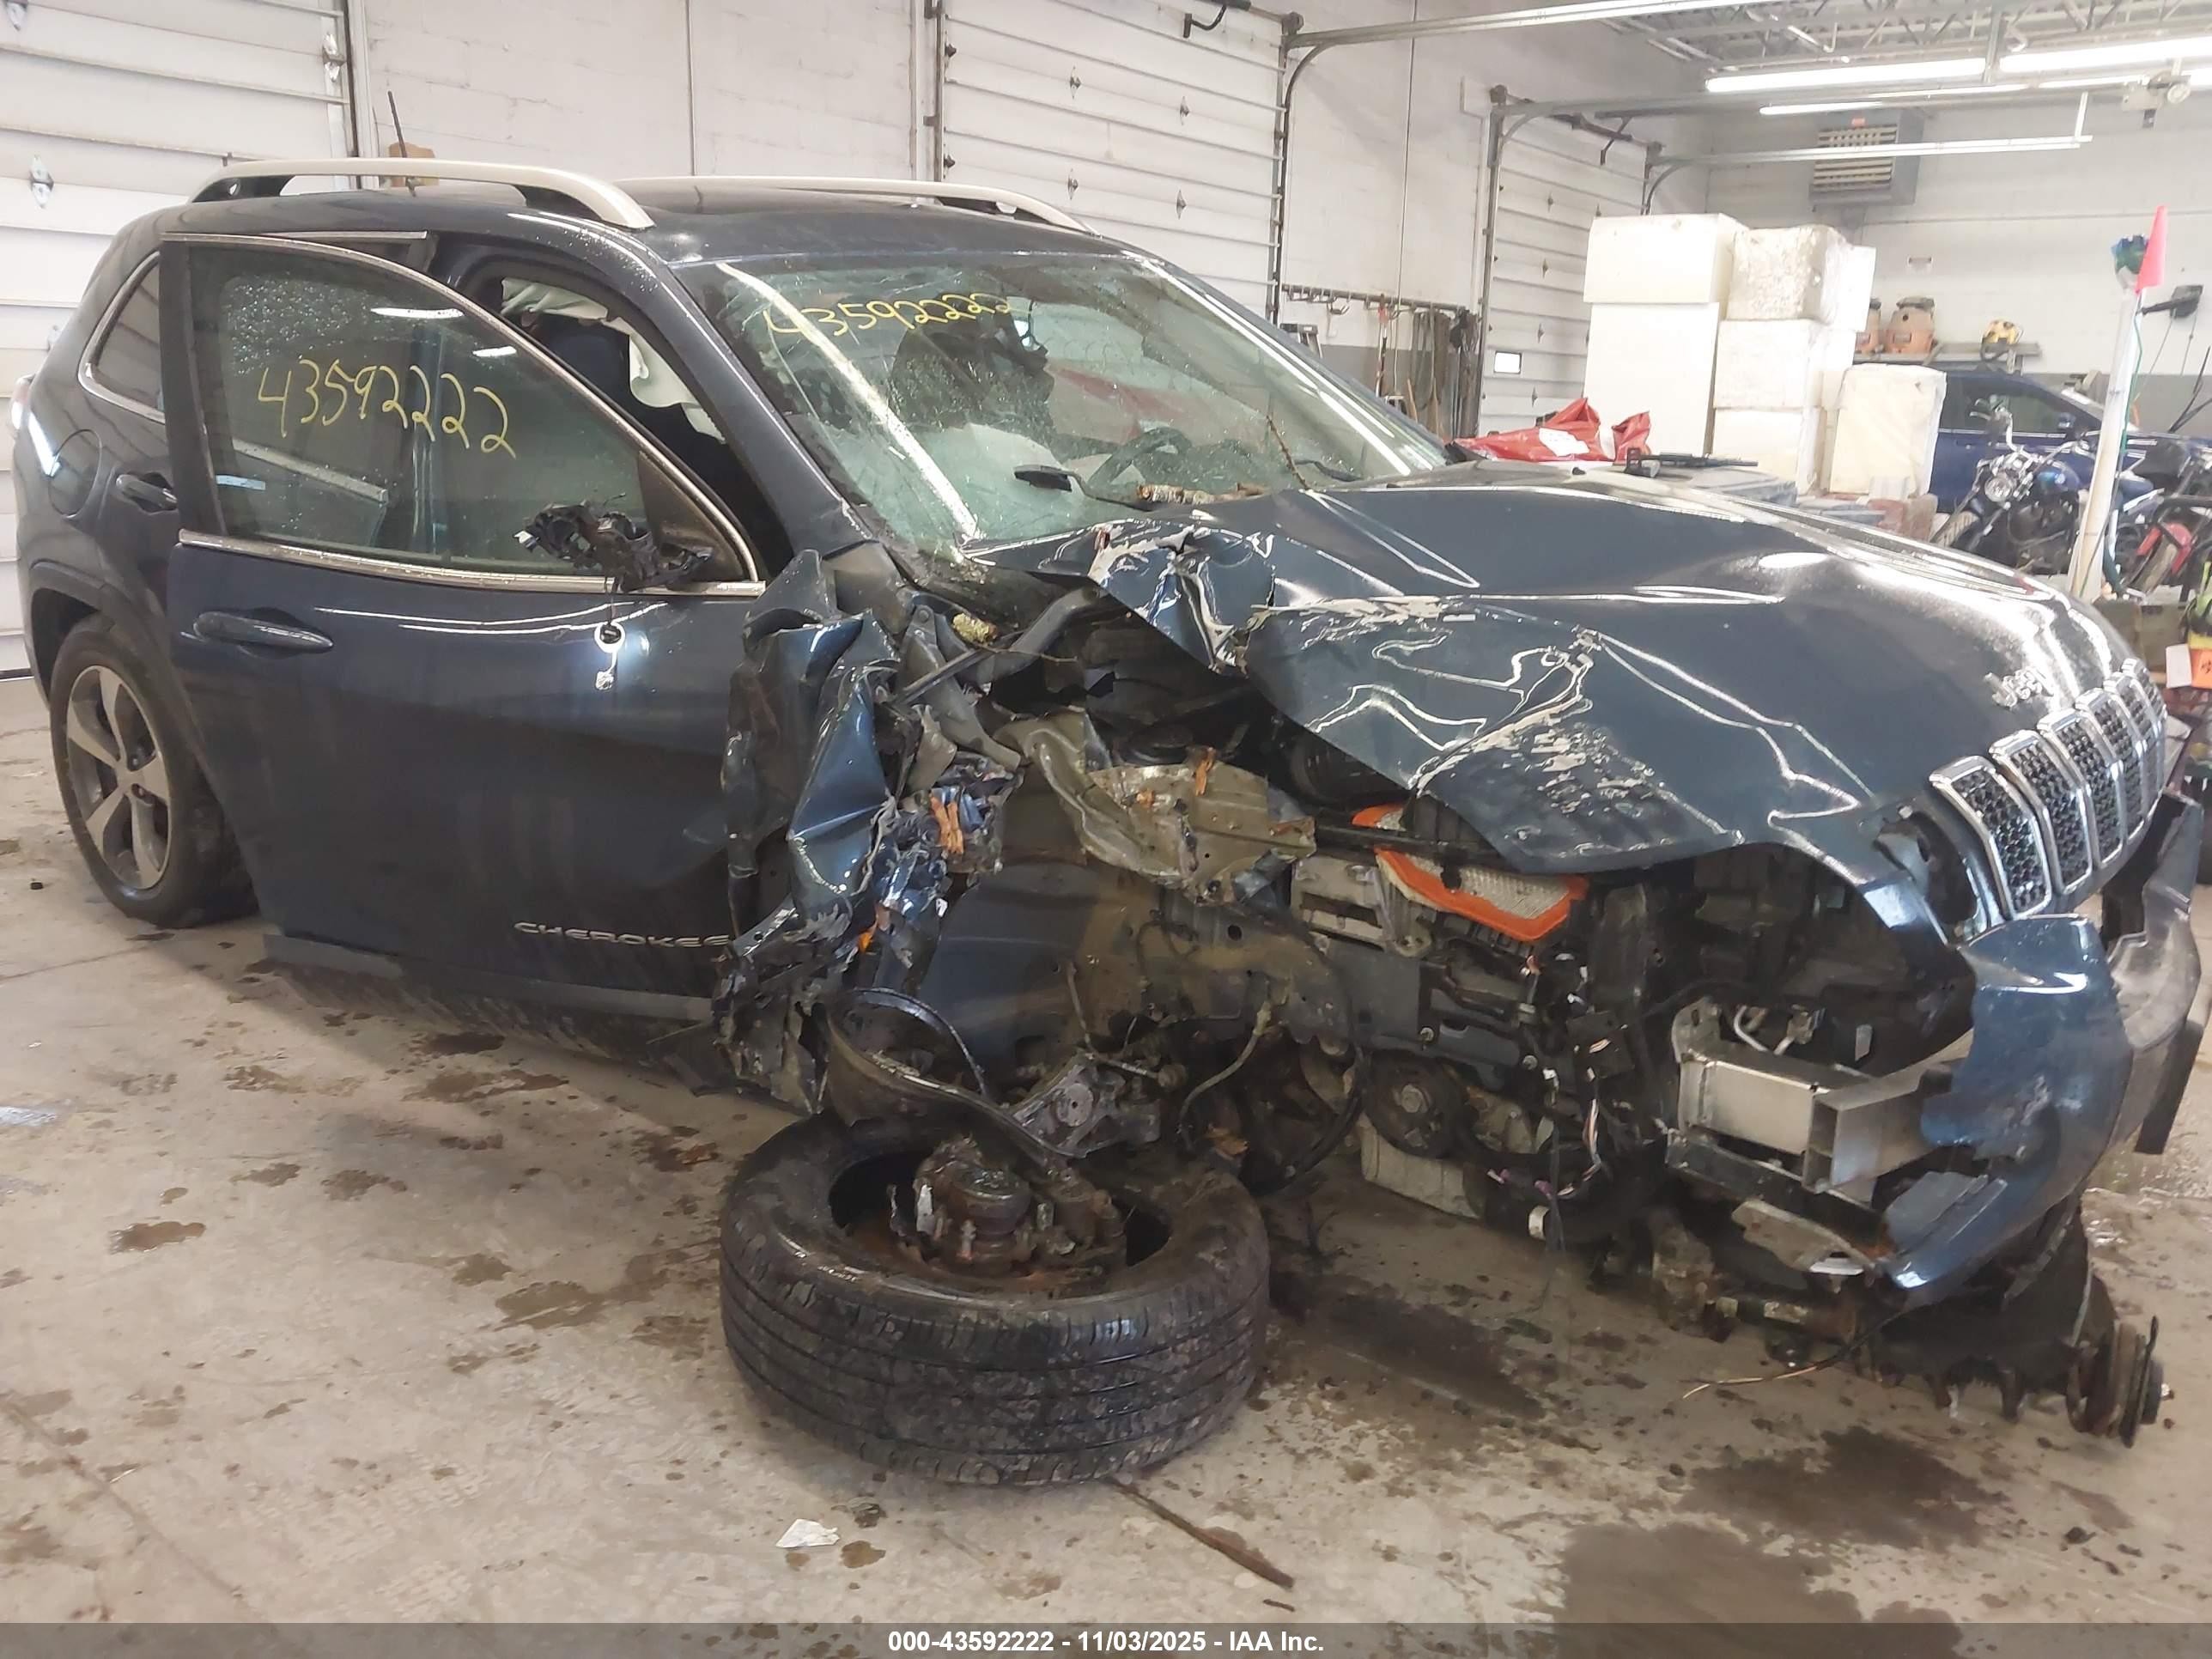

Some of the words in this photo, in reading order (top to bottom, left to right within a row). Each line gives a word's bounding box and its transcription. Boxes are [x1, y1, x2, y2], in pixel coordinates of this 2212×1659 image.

[763, 293, 1031, 337] 43592222
[258, 359, 516, 459] 43592222
[514, 921, 730, 948] CHEROKEE
